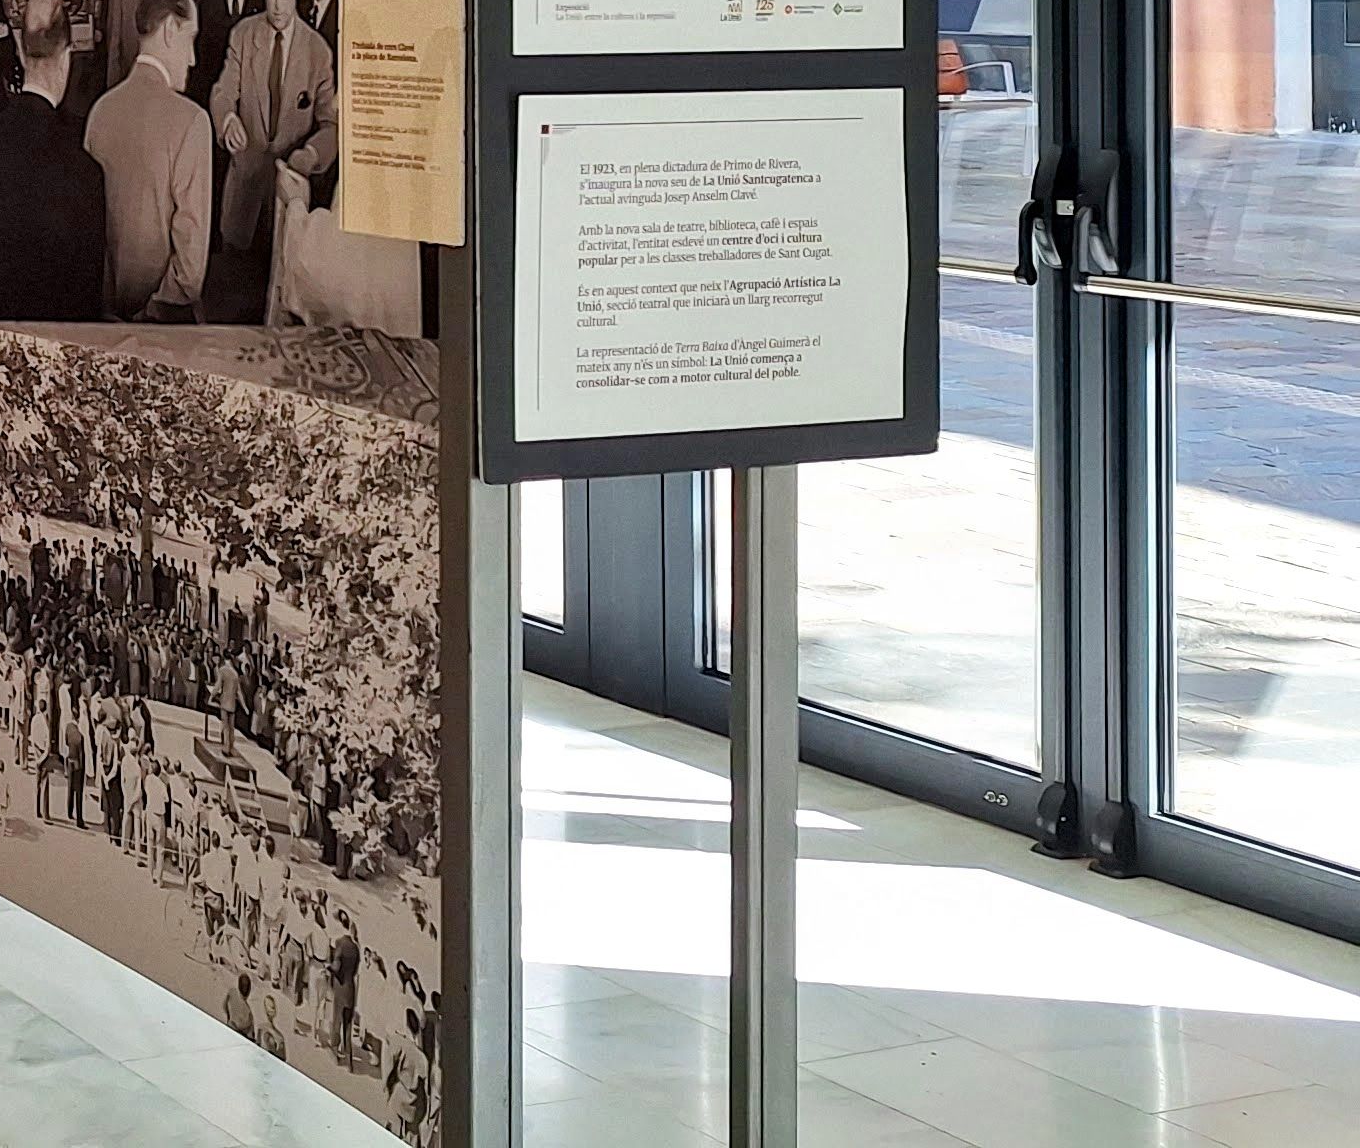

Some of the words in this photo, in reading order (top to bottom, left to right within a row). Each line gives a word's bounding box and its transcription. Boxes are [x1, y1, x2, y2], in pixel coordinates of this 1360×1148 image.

[581, 164, 589, 174] El
[593, 164, 617, 175] 1923,
[620, 165, 631, 173] en
[635, 162, 660, 175] plena
[663, 160, 707, 172] dictadura
[711, 160, 721, 171] de
[724, 160, 752, 170] Primo
[755, 159, 766, 169] de
[769, 158, 800, 169] Rivera,
[635, 177, 642, 188] la
[645, 179, 668, 187] nova
[671, 179, 686, 187] seu
[690, 176, 700, 186] de
[703, 176, 714, 185] La
[718, 174, 740, 185] Unió
[743, 174, 813, 187] Santcugatenca
[579, 194, 615, 205] l'actual
[618, 192, 662, 206] avinguda
[692, 190, 728, 201] Anselm
[580, 224, 603, 236] Amb
[605, 224, 613, 234] la
[616, 226, 639, 234] nova
[643, 222, 661, 233] sala
[664, 222, 674, 232] de
[677, 223, 707, 233] teatre,
[710, 220, 758, 231] biblioteca,
[761, 218, 780, 229] cafè
[788, 217, 818, 232] espais
[579, 240, 630, 251] d'activitat,
[633, 239, 669, 249] l'entitat
[672, 236, 704, 247] esdevé
[722, 237, 753, 245] centre
[756, 233, 778, 244] d'oci
[787, 233, 822, 243] cultura
[579, 255, 618, 269] popular
[621, 256, 636, 268] per
[647, 253, 660, 263] les
[663, 253, 696, 263] classes
[699, 249, 761, 261] treballadores
[765, 249, 776, 258] de
[779, 248, 800, 258] Sant
[607, 286, 639, 298] aquest
[641, 284, 677, 294] context
[680, 284, 697, 295] que
[701, 281, 720, 291] neix
[724, 278, 781, 292] l'Agrupació
[783, 276, 826, 288] Artística
[829, 276, 840, 286] La
[578, 301, 604, 312] Unió,
[639, 297, 670, 309] teatral
[673, 299, 690, 310] que
[693, 296, 730, 307] iniciarà
[748, 294, 770, 307] llarg
[773, 293, 822, 305] recorregut
[577, 348, 588, 358] La
[592, 343, 658, 359] representació
[661, 343, 672, 353] de
[676, 343, 699, 353] Terra
[703, 341, 728, 351] Baixa
[731, 337, 766, 352] d'Àngel
[769, 336, 810, 348] Guimerà
[813, 336, 820, 346] el
[577, 363, 610, 372] mateix
[613, 362, 631, 373] any
[635, 359, 653, 370] n'és
[671, 356, 707, 368] símbol:
[711, 357, 722, 366] La
[725, 353, 748, 365] Unió
[751, 354, 794, 364] comença
[577, 375, 645, 388] consolidar-se
[649, 375, 669, 385] com
[681, 372, 711, 383] motor
[714, 369, 752, 381] cultural
[755, 368, 769, 379] del
